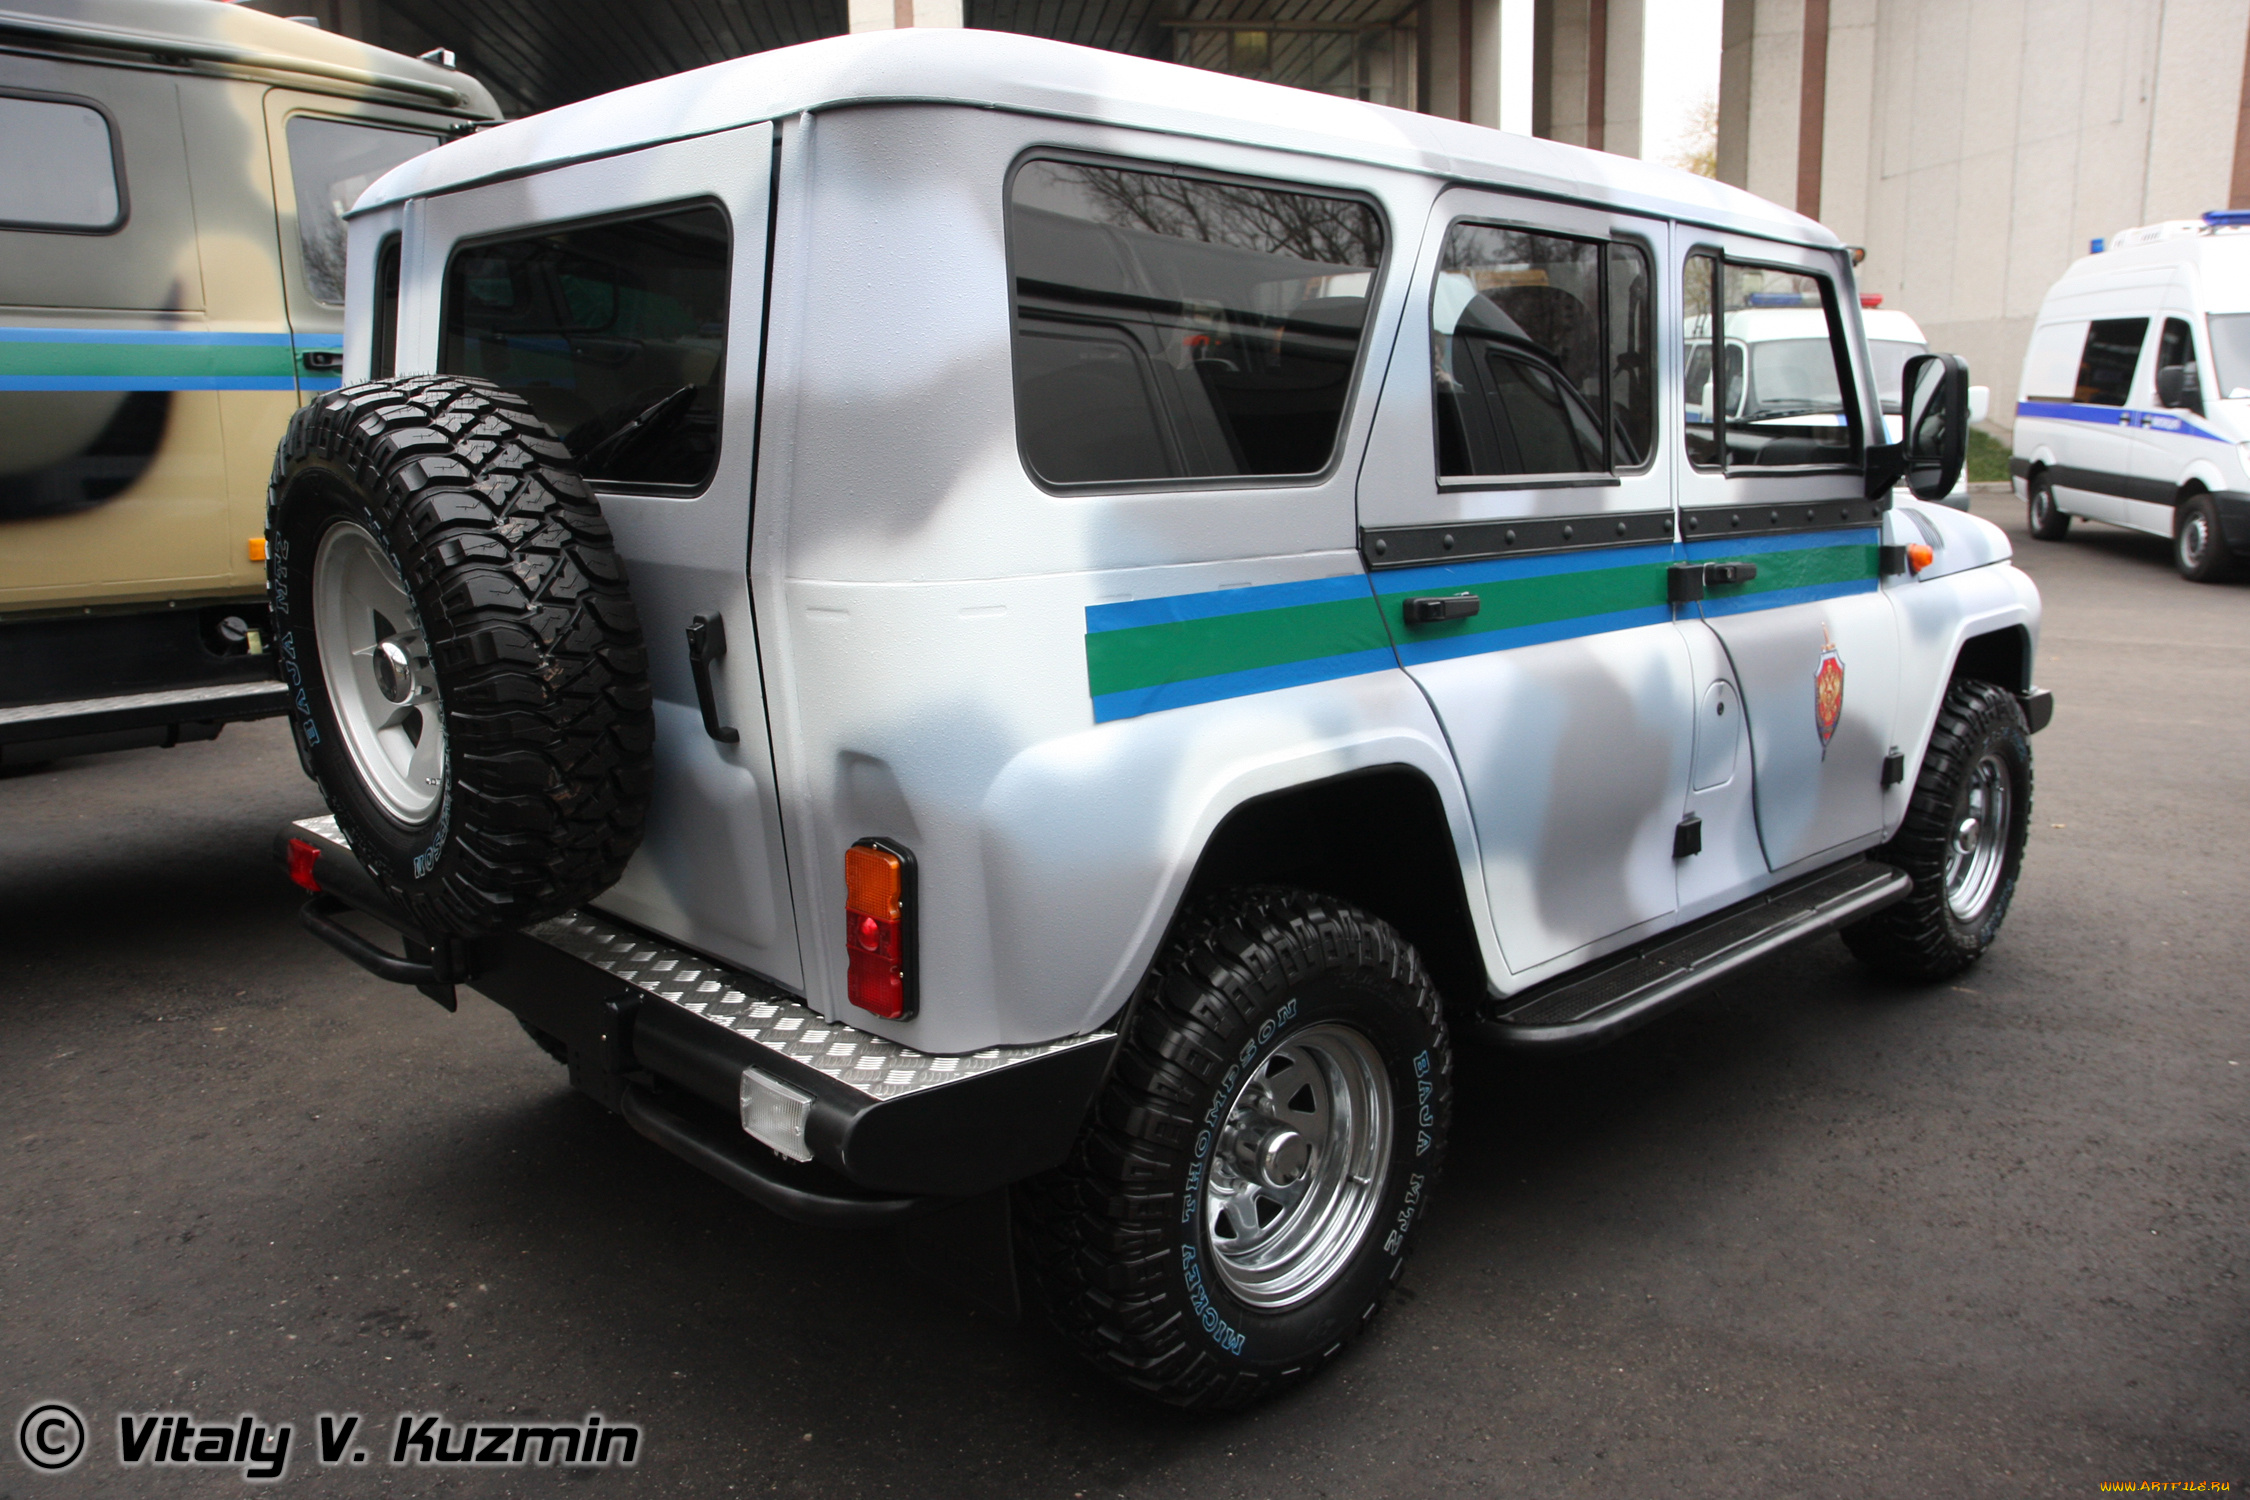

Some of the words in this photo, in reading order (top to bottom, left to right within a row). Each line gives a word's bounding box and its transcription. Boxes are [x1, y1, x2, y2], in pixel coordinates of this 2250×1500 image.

[281, 631, 320, 748] BAJA
[1182, 998, 1298, 1223] THOMPSON
[1413, 1050, 1433, 1157] BAJA
[1181, 1244, 1246, 1356] MICKEY
